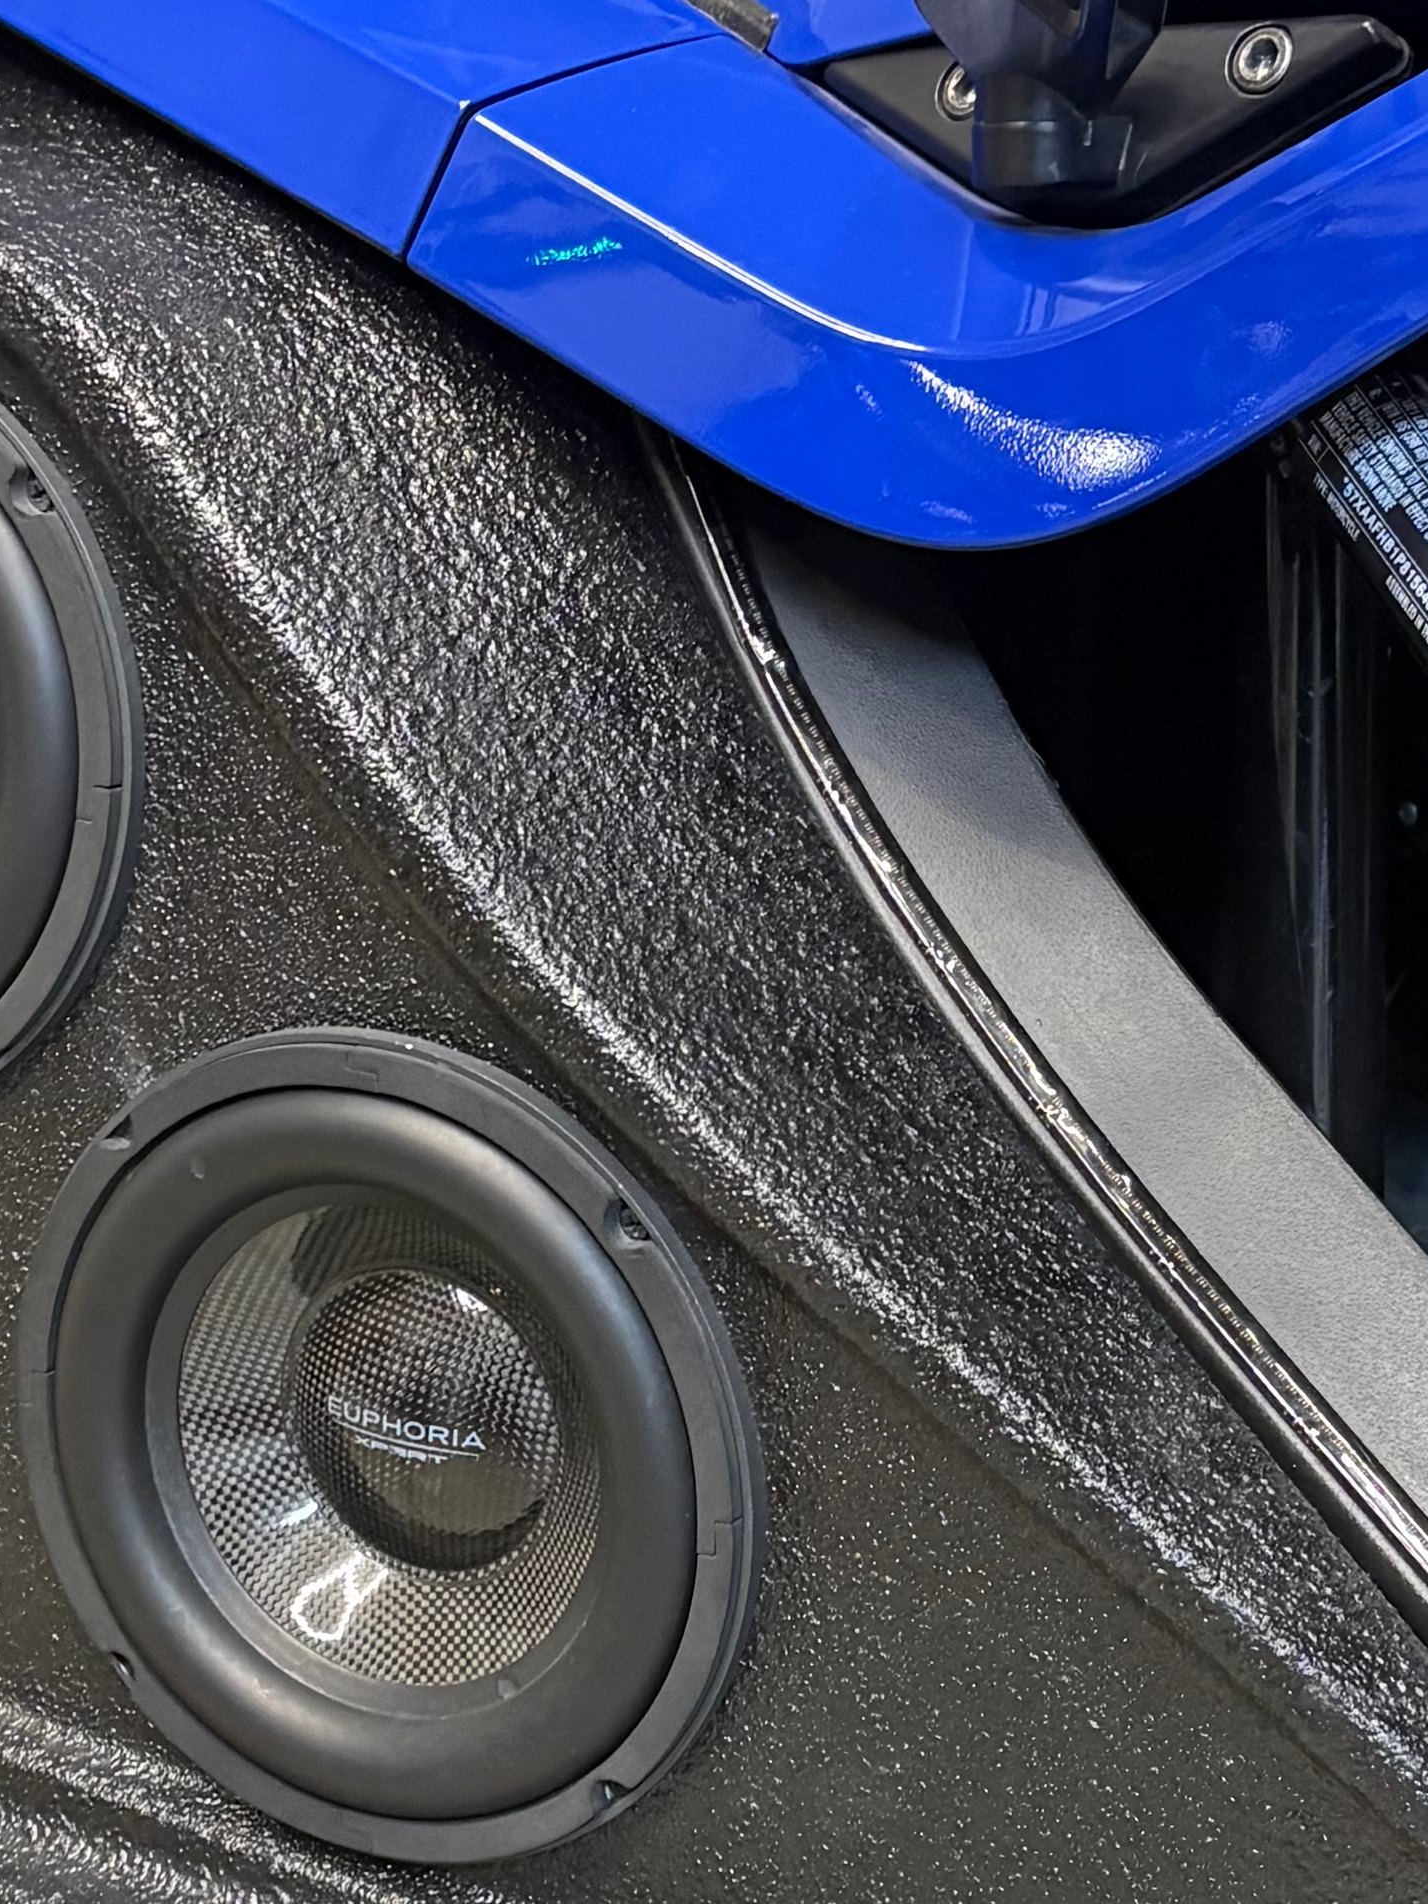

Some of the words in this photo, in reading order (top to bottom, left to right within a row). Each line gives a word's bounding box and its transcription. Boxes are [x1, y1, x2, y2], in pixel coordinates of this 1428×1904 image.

[1377, 435, 1412, 474] CONFORMS
[1410, 481, 1428, 498] ALL
[328, 1396, 486, 1450] EUPHORIA
